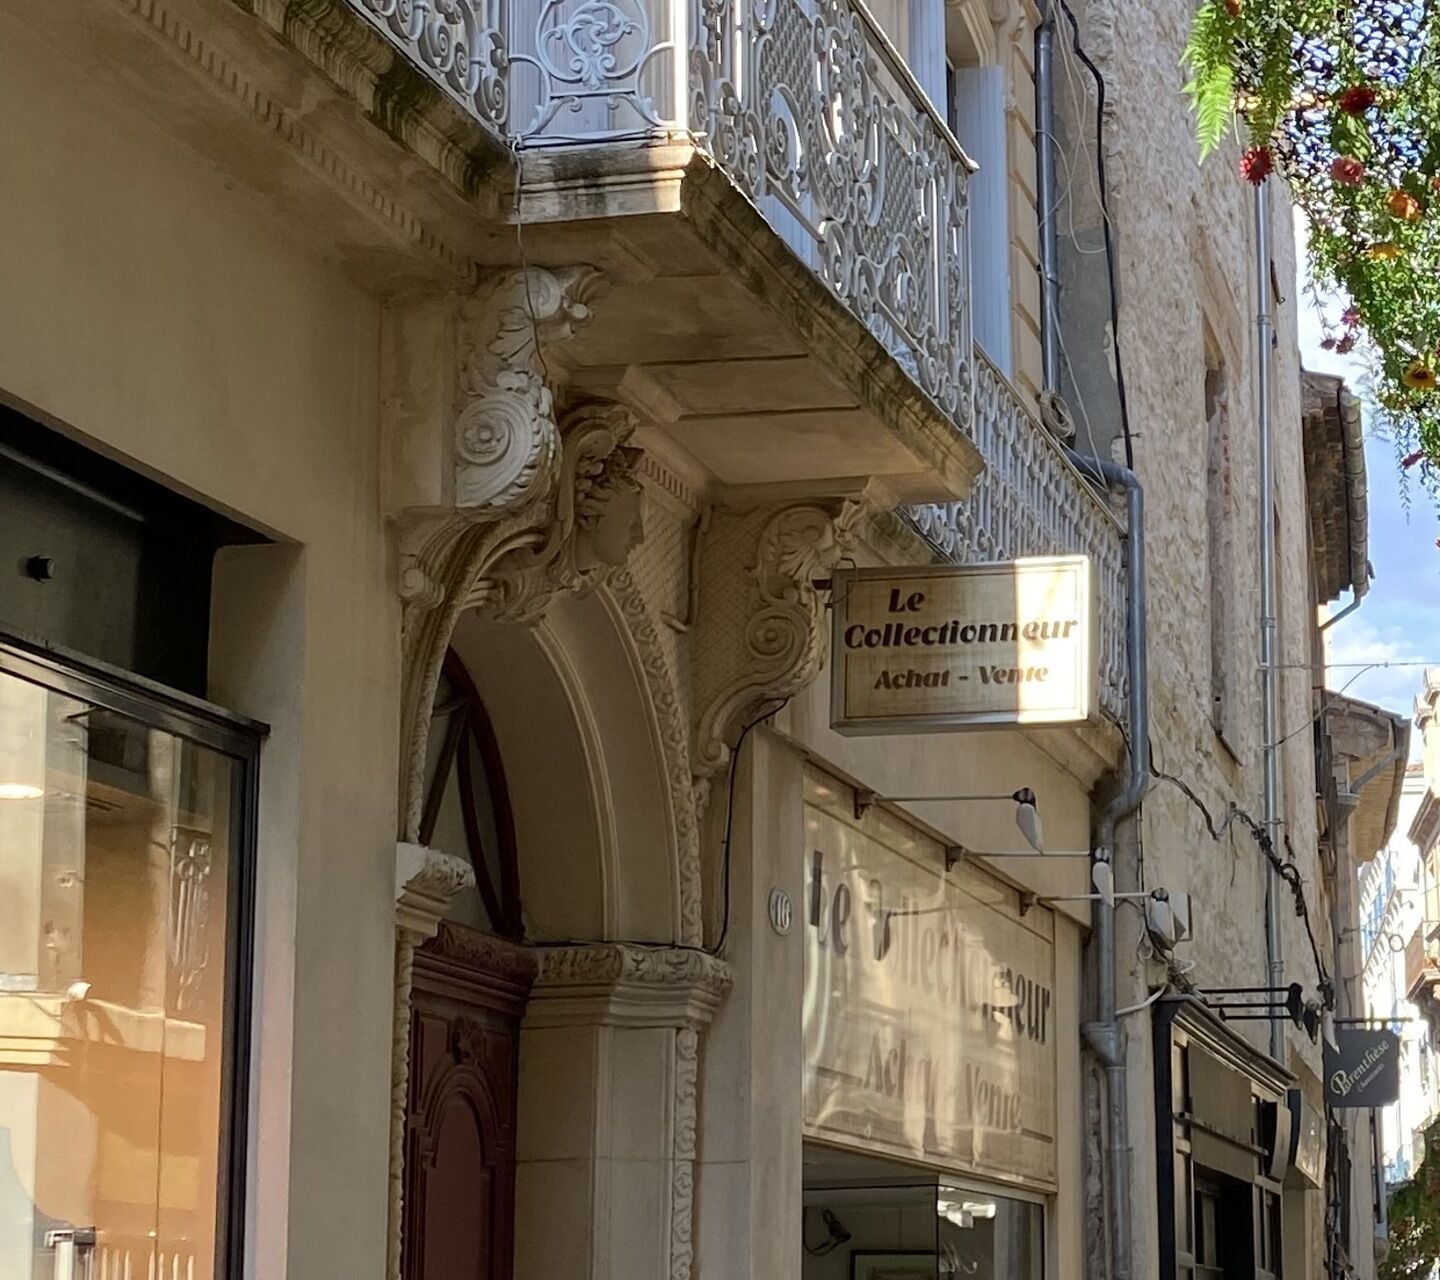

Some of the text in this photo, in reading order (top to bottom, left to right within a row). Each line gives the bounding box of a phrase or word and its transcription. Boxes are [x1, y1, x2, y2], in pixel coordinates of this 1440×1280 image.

[888, 588, 925, 613] Le
[844, 619, 1078, 649] Collectionneur
[874, 668, 951, 690] Achat
[979, 665, 1049, 685] Vente
